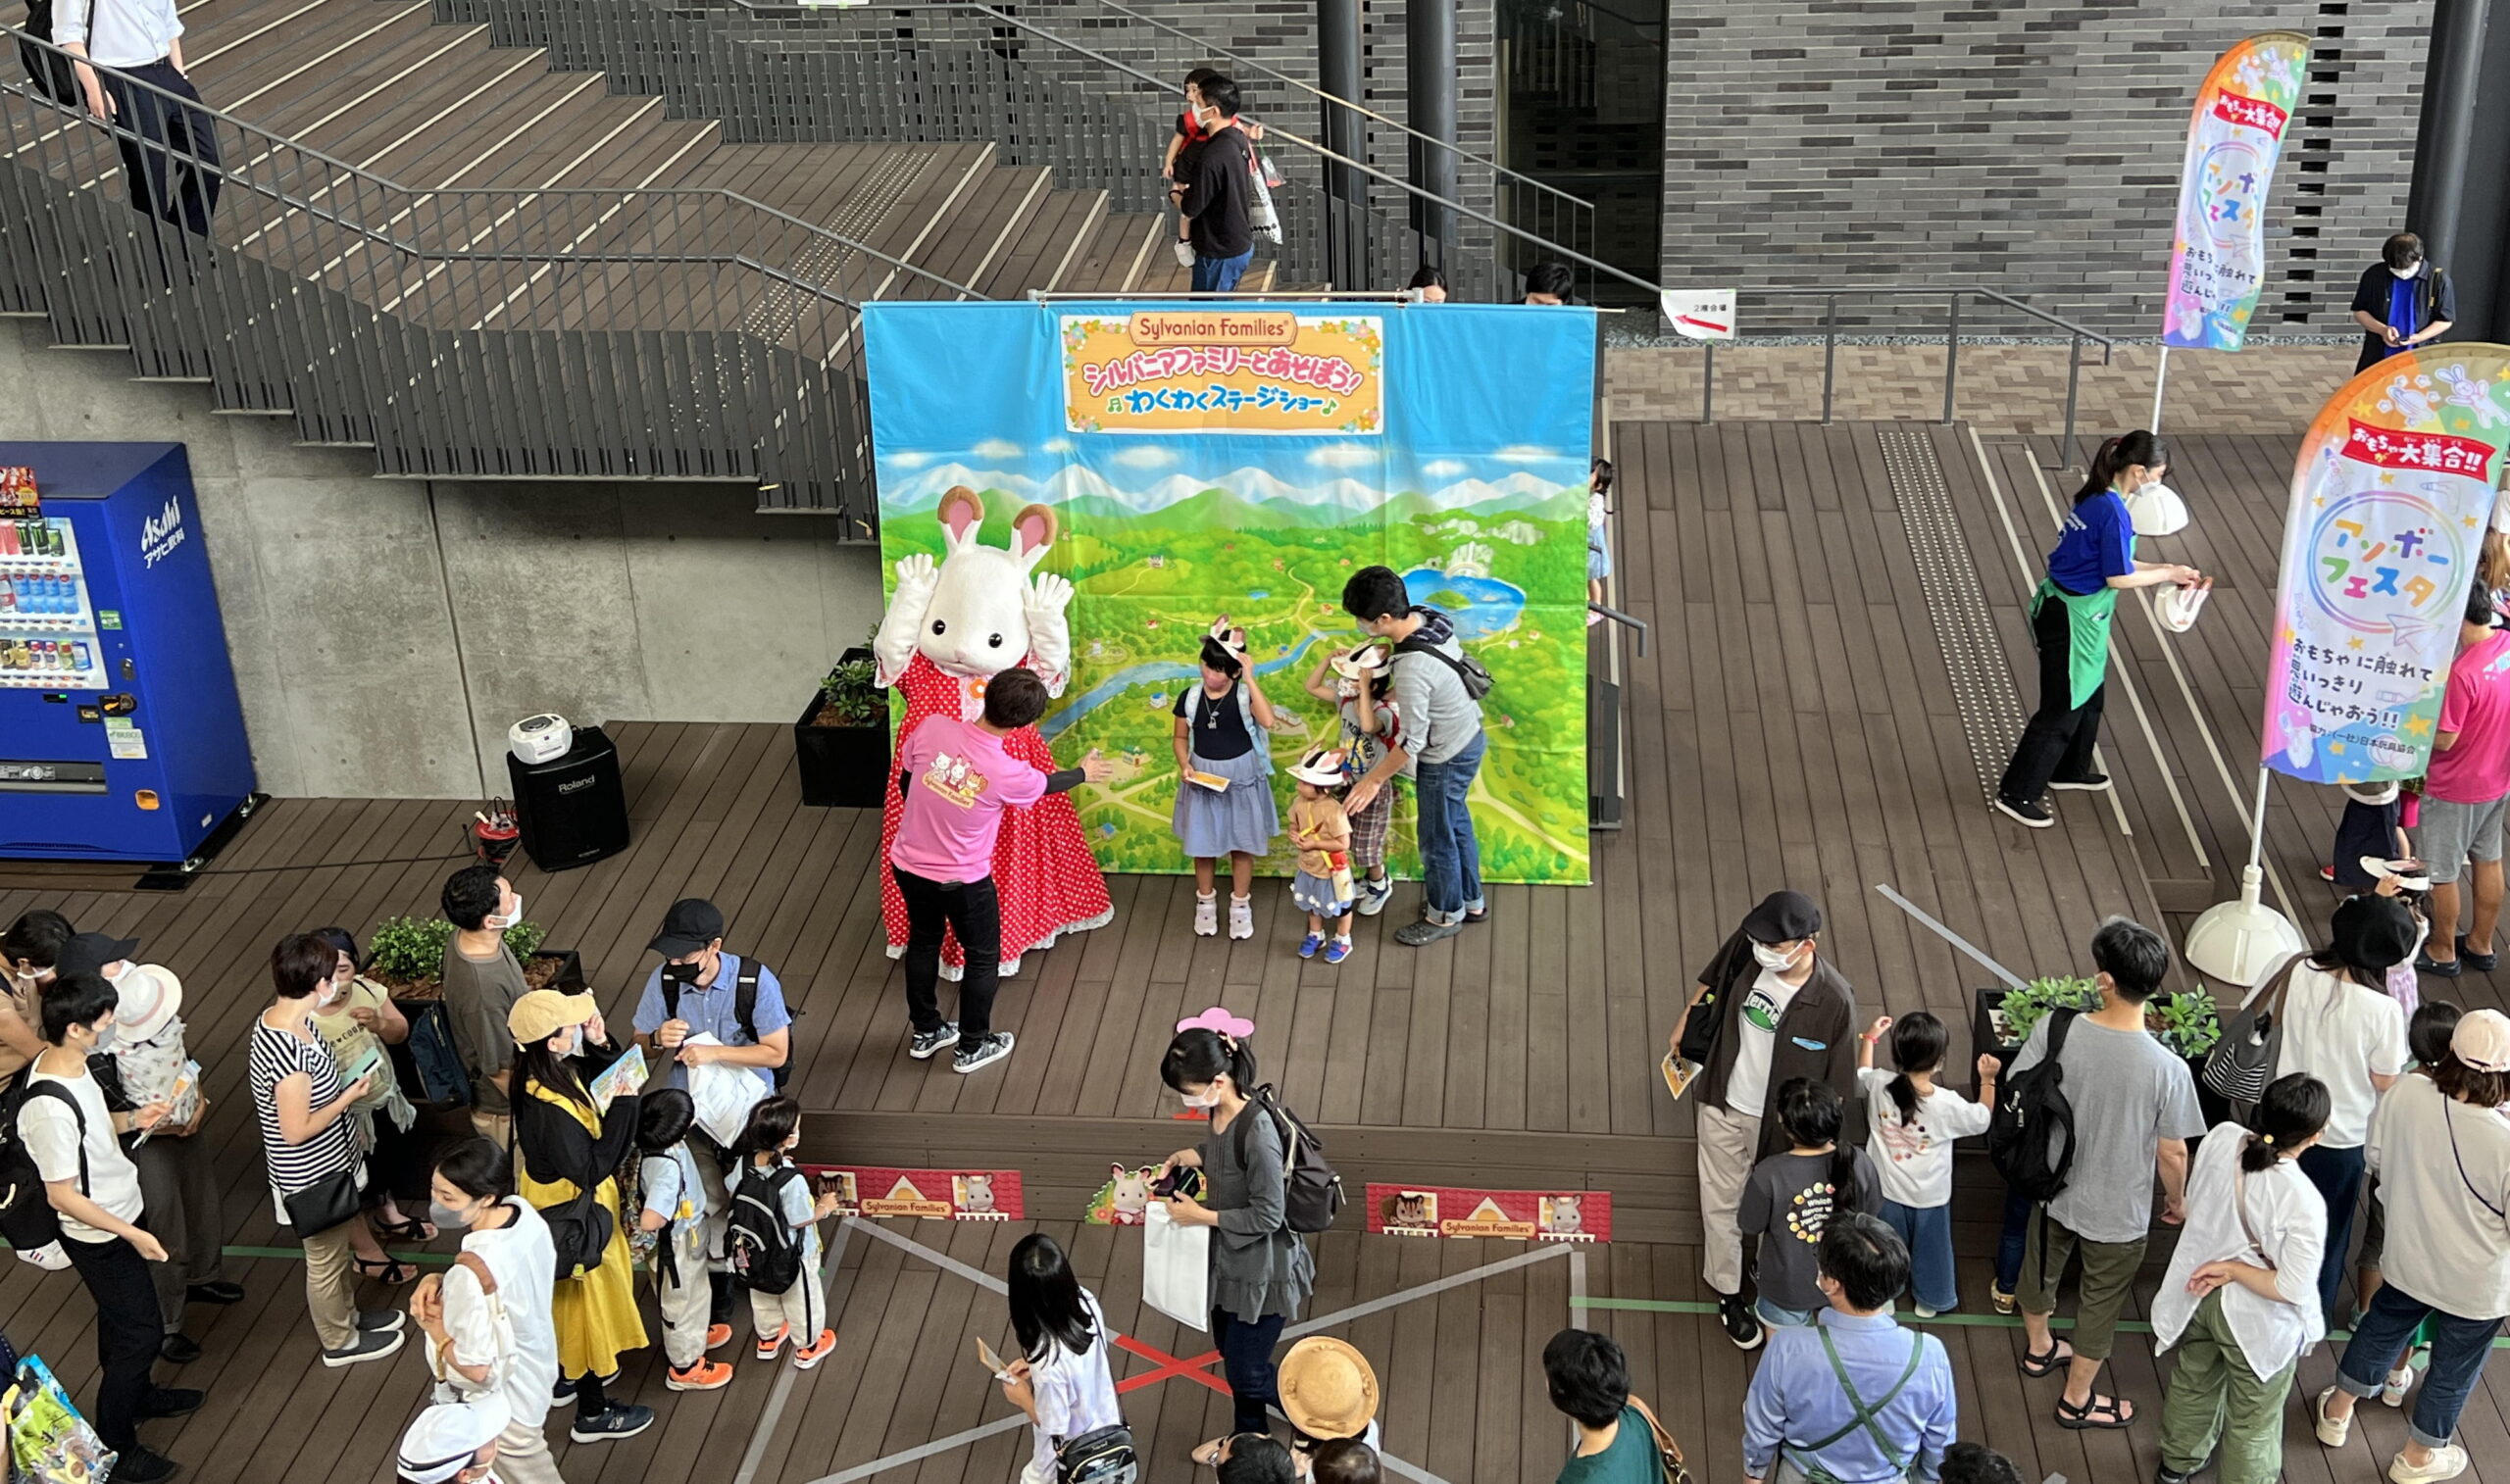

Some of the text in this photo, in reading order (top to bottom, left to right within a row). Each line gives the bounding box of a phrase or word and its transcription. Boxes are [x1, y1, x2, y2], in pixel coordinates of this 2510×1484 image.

[1140, 318, 1284, 340] Sylvanian Families
[1085, 347, 1360, 394] シルバニアファミリーとあそぼう!
[1125, 385, 1324, 413] わくわくステージショー
[141, 494, 180, 553] Asahi
[144, 527, 184, 569] アサヒ飲料
[2321, 556, 2436, 608] フェスタ
[558, 774, 595, 793] Roland
[866, 1201, 945, 1212] Sylvanian Families
[1446, 1221, 1529, 1233] Sylvanian Families
